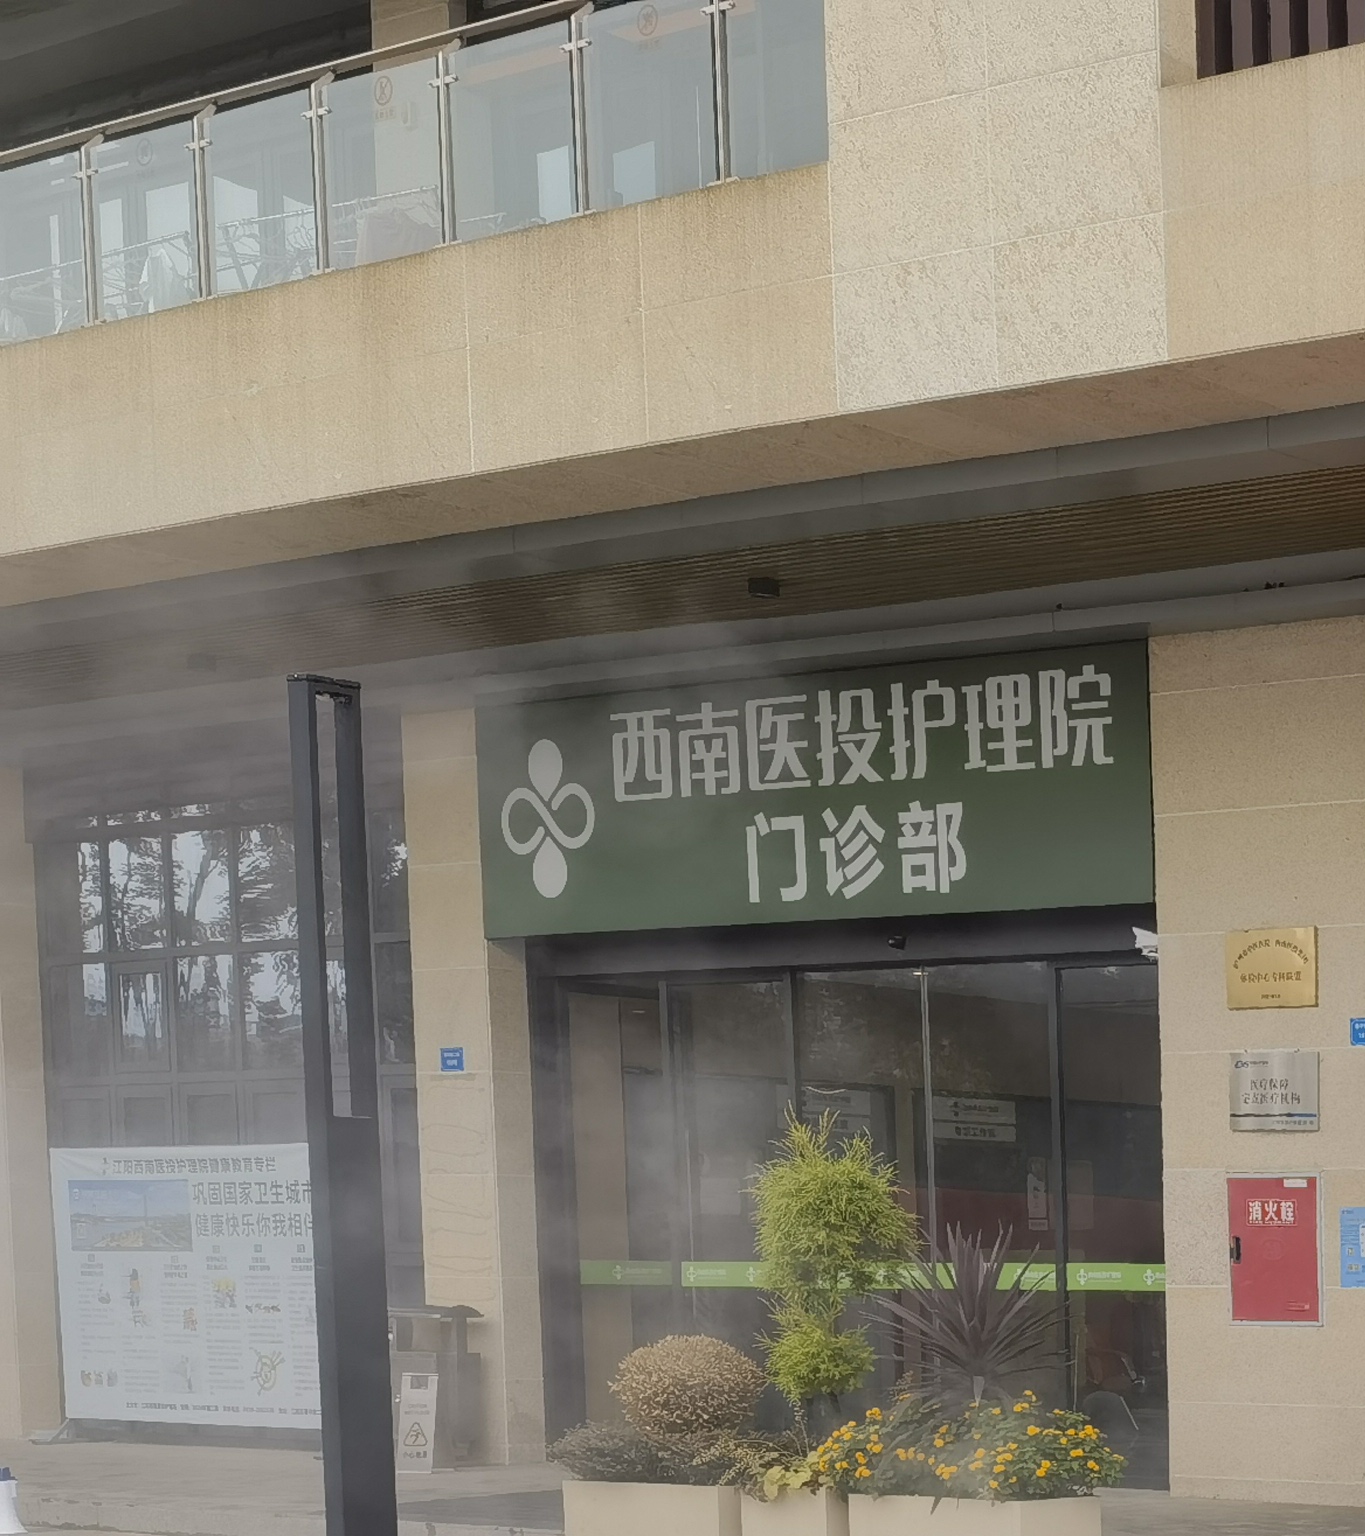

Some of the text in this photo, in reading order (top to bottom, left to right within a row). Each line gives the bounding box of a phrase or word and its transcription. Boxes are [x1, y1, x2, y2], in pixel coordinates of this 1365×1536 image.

[610, 664, 1113, 802] 西南医投护理院
[745, 801, 966, 903] 门诊部
[192, 1179, 312, 1205] 巩固国家卫生城市
[1248, 1200, 1294, 1221] 消火栓
